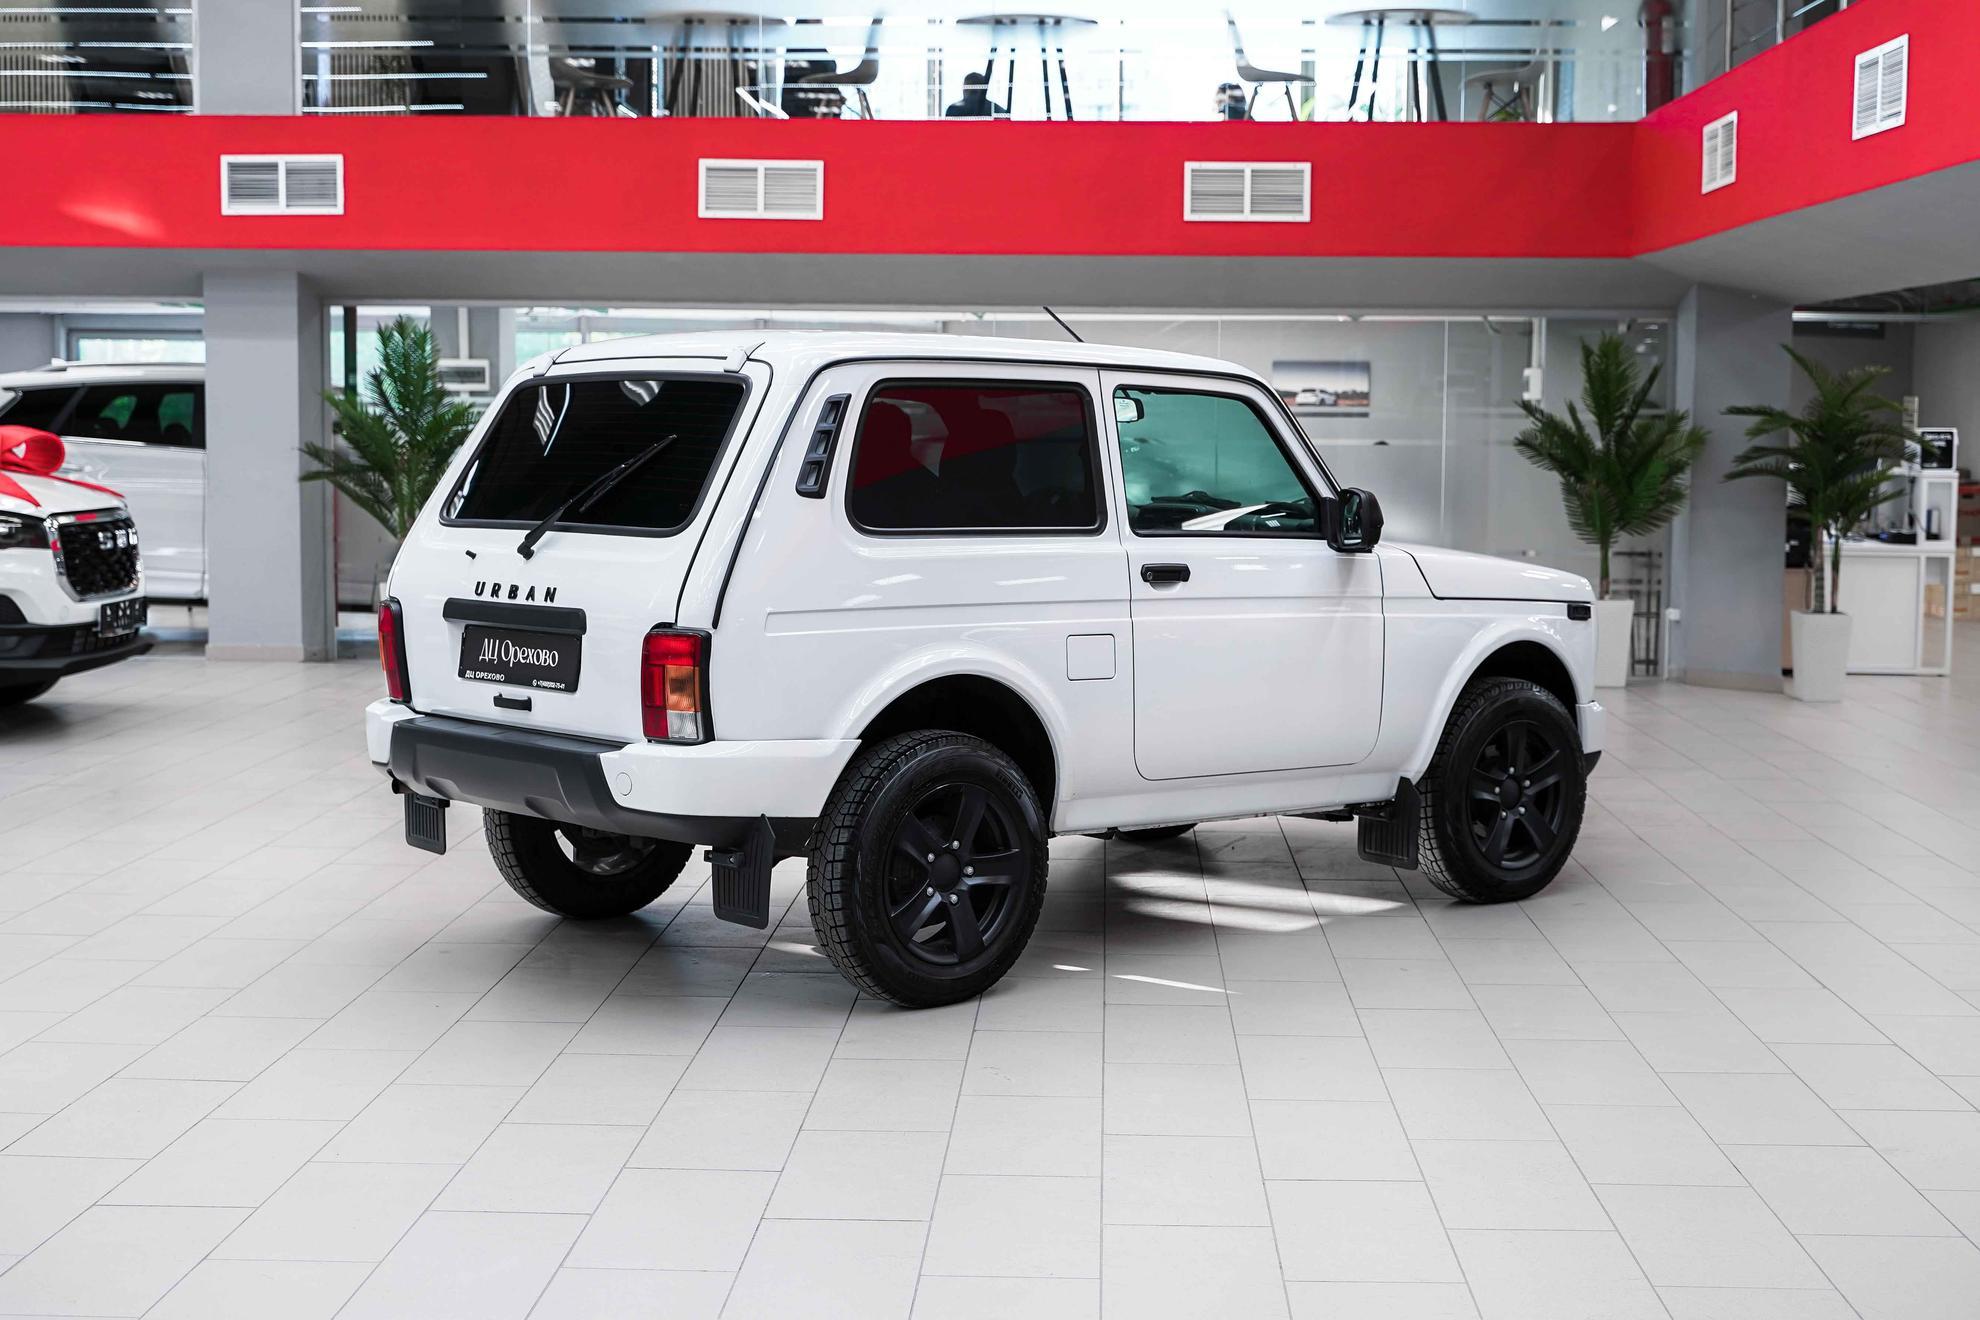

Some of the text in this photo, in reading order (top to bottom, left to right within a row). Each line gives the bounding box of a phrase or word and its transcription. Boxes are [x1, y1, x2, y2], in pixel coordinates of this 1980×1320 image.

[474, 581, 557, 603] URBAN
[479, 638, 559, 668] ДЦ Орехово
[465, 670, 505, 682] ДЦ ОРЕХОВО
